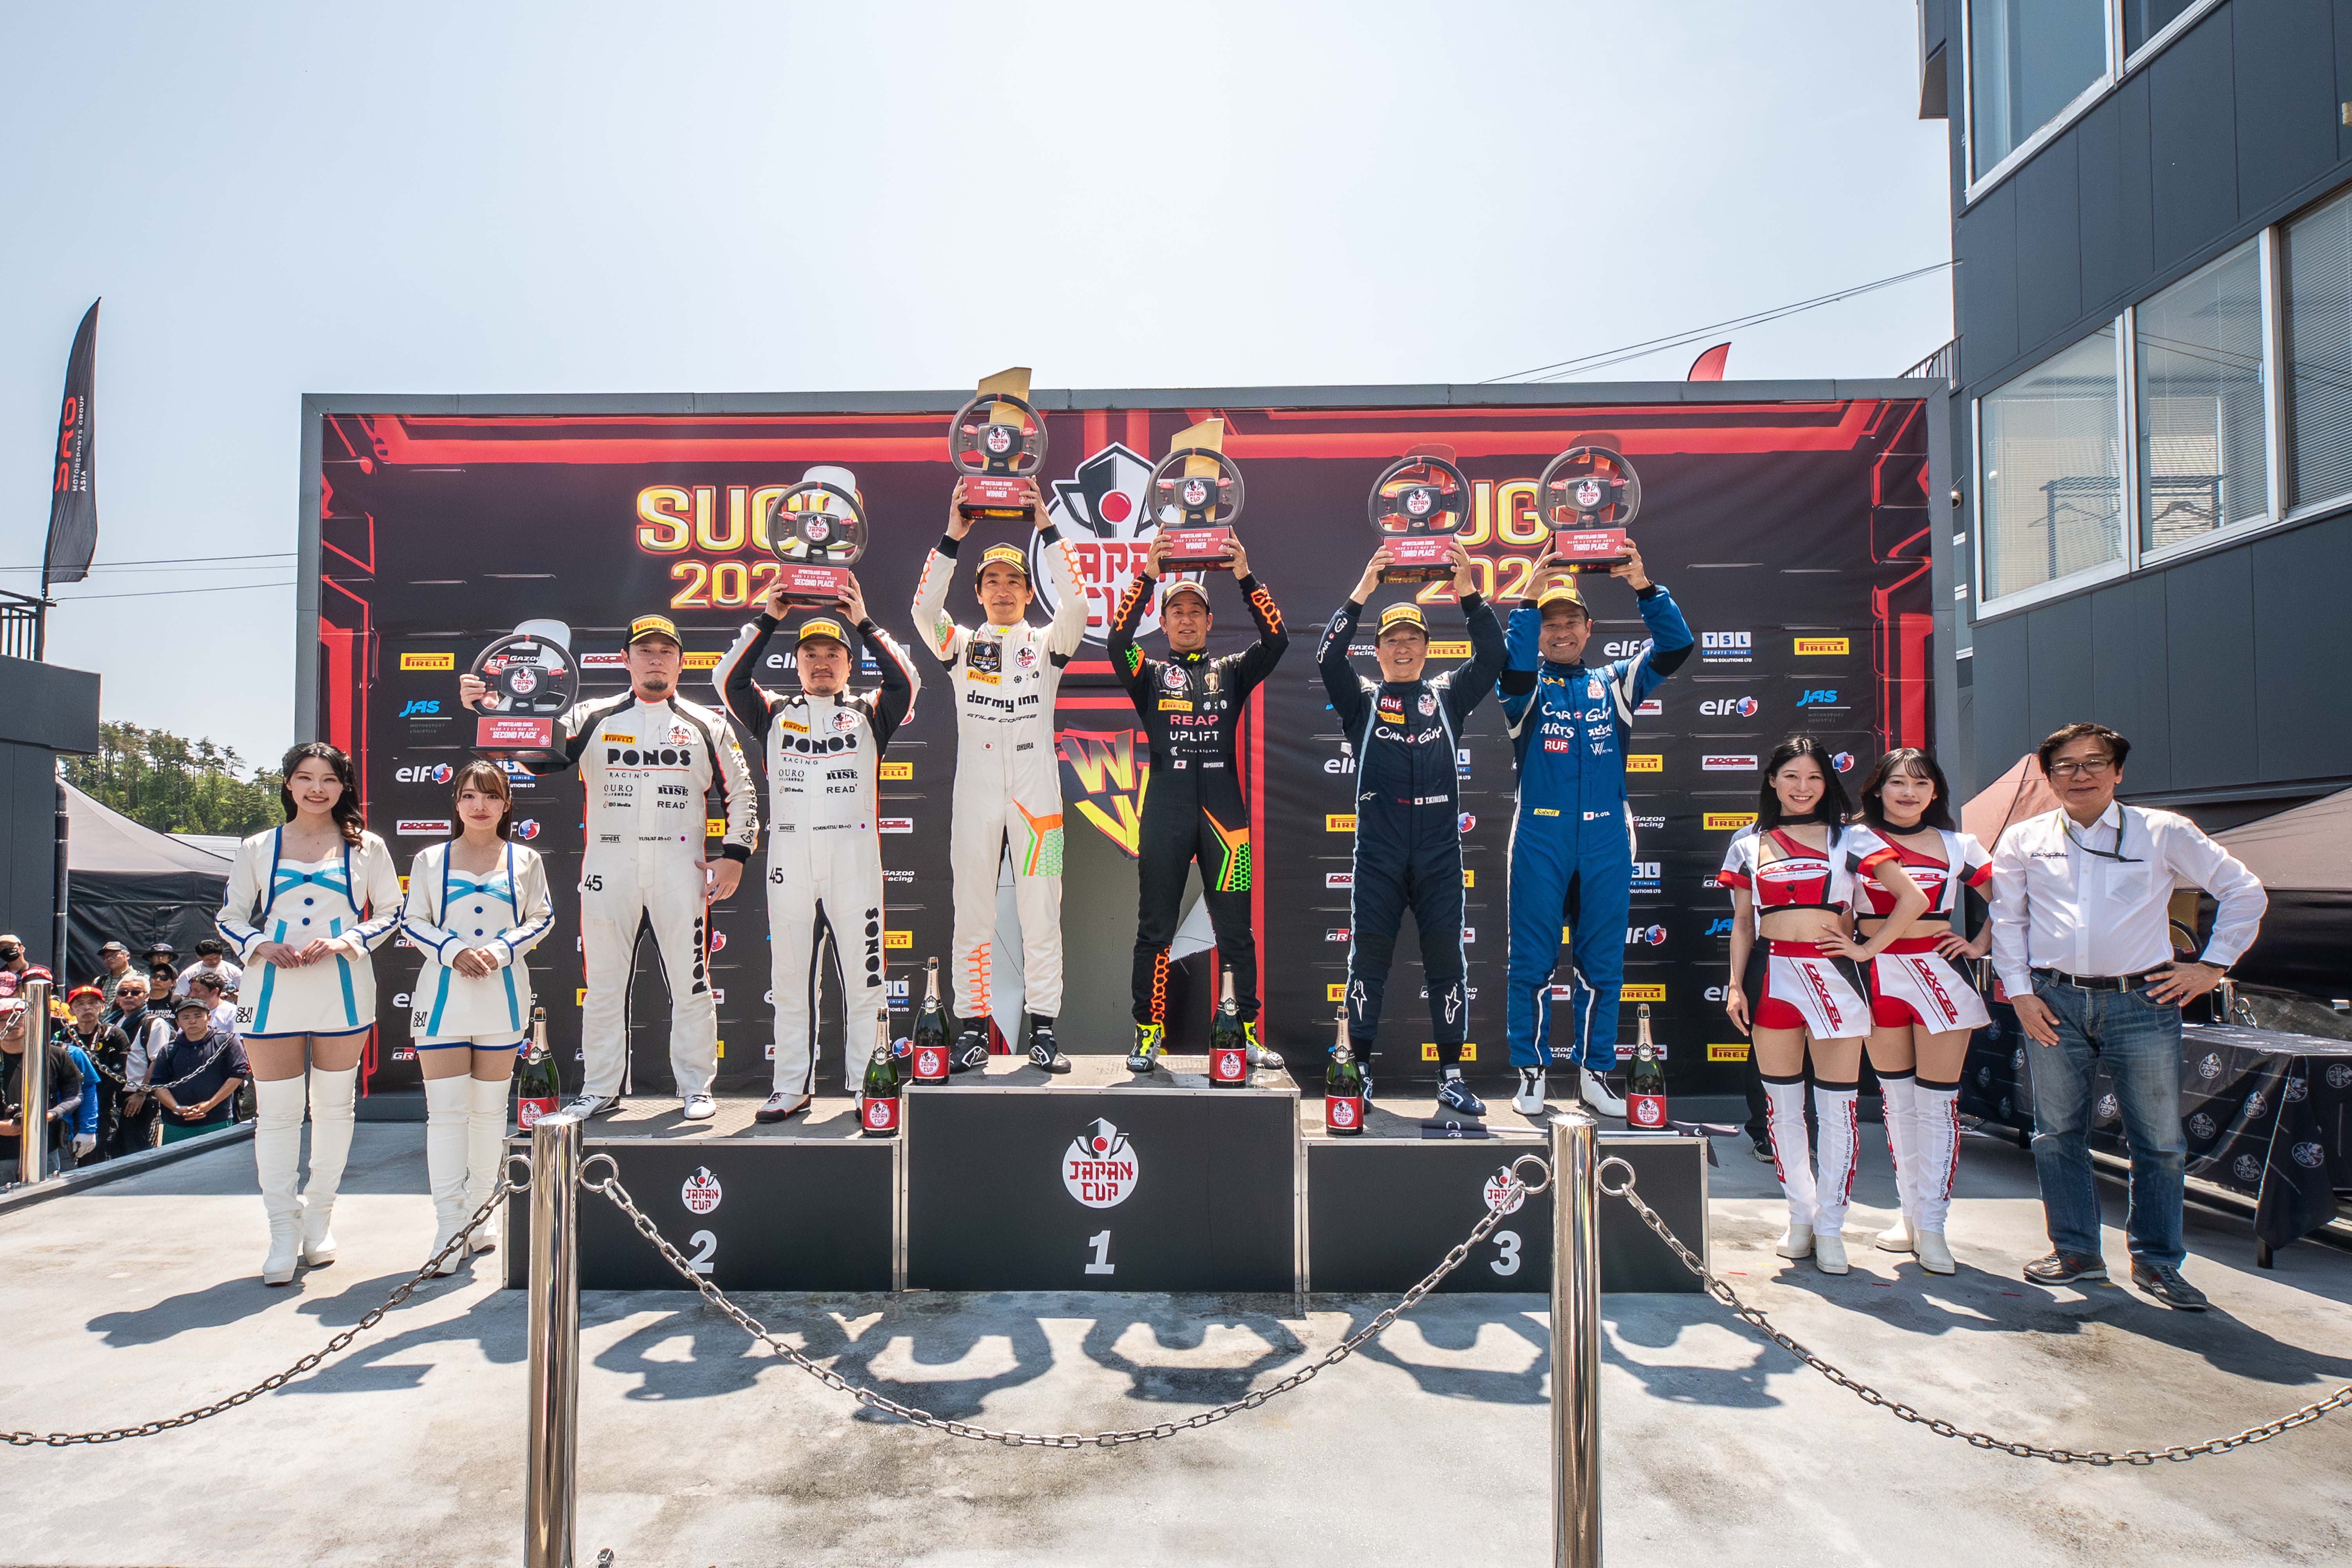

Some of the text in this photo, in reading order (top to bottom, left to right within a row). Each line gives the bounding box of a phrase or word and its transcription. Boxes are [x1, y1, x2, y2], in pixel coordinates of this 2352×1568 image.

[671, 559, 784, 609] 202
[794, 578, 835, 588] SECOND PLACE
[1706, 635, 1747, 645] TSL
[1799, 641, 1844, 652] PIRELLI
[1429, 645, 1466, 655] IRELLI
[1603, 641, 1641, 657] elf
[405, 656, 449, 667] PIRELLI
[969, 671, 998, 684] PIRELLI
[967, 690, 1014, 713] dormy
[1380, 697, 1402, 710] RUF
[1796, 690, 1838, 707] JAS
[399, 700, 440, 717] JAS
[1541, 701, 1612, 722] CAR GUY
[1699, 699, 1737, 715] elf
[1170, 714, 1218, 726] REAP
[1170, 731, 1219, 742] UPLIFT
[1375, 726, 1443, 744] CAR GUY
[1540, 722, 1575, 739] ARTS
[605, 734, 633, 743] PIRELLI
[782, 733, 857, 754] PONOS
[1016, 742, 1034, 751] OKURA
[1544, 740, 1568, 751] RUF
[607, 748, 691, 766] PONOS
[784, 757, 818, 765] RACING
[1704, 757, 1756, 766] DIXCEL
[395, 766, 432, 782] elf
[826, 771, 858, 780] RISE
[604, 784, 633, 792] OURO
[658, 786, 689, 796] RISE
[657, 800, 685, 809] READ
[399, 822, 449, 830] DIXCEL
[1331, 818, 1356, 828] PIRE
[769, 867, 784, 884] 45
[1759, 863, 1829, 876] DIXCEL
[584, 874, 603, 891] 45
[1705, 918, 1733, 936] JA
[1327, 933, 1349, 941] GR
[865, 907, 882, 988] PONOS
[692, 916, 707, 995] PONOS
[1622, 988, 1661, 998] IRELLI
[1803, 962, 1842, 1032] DIXCEL
[1910, 958, 1958, 1025] DIXCEL
[393, 1052, 415, 1060] GR
[1712, 1047, 1748, 1058] PIREL
[1069, 1161, 1133, 1180] JAPAN
[685, 1189, 719, 1199] JAPAN
[1080, 1182, 1118, 1201] CUP
[691, 1200, 711, 1210] CUP
[686, 1230, 717, 1273] 2
[1084, 1230, 1115, 1274] 1
[1490, 1230, 1521, 1276] 3
